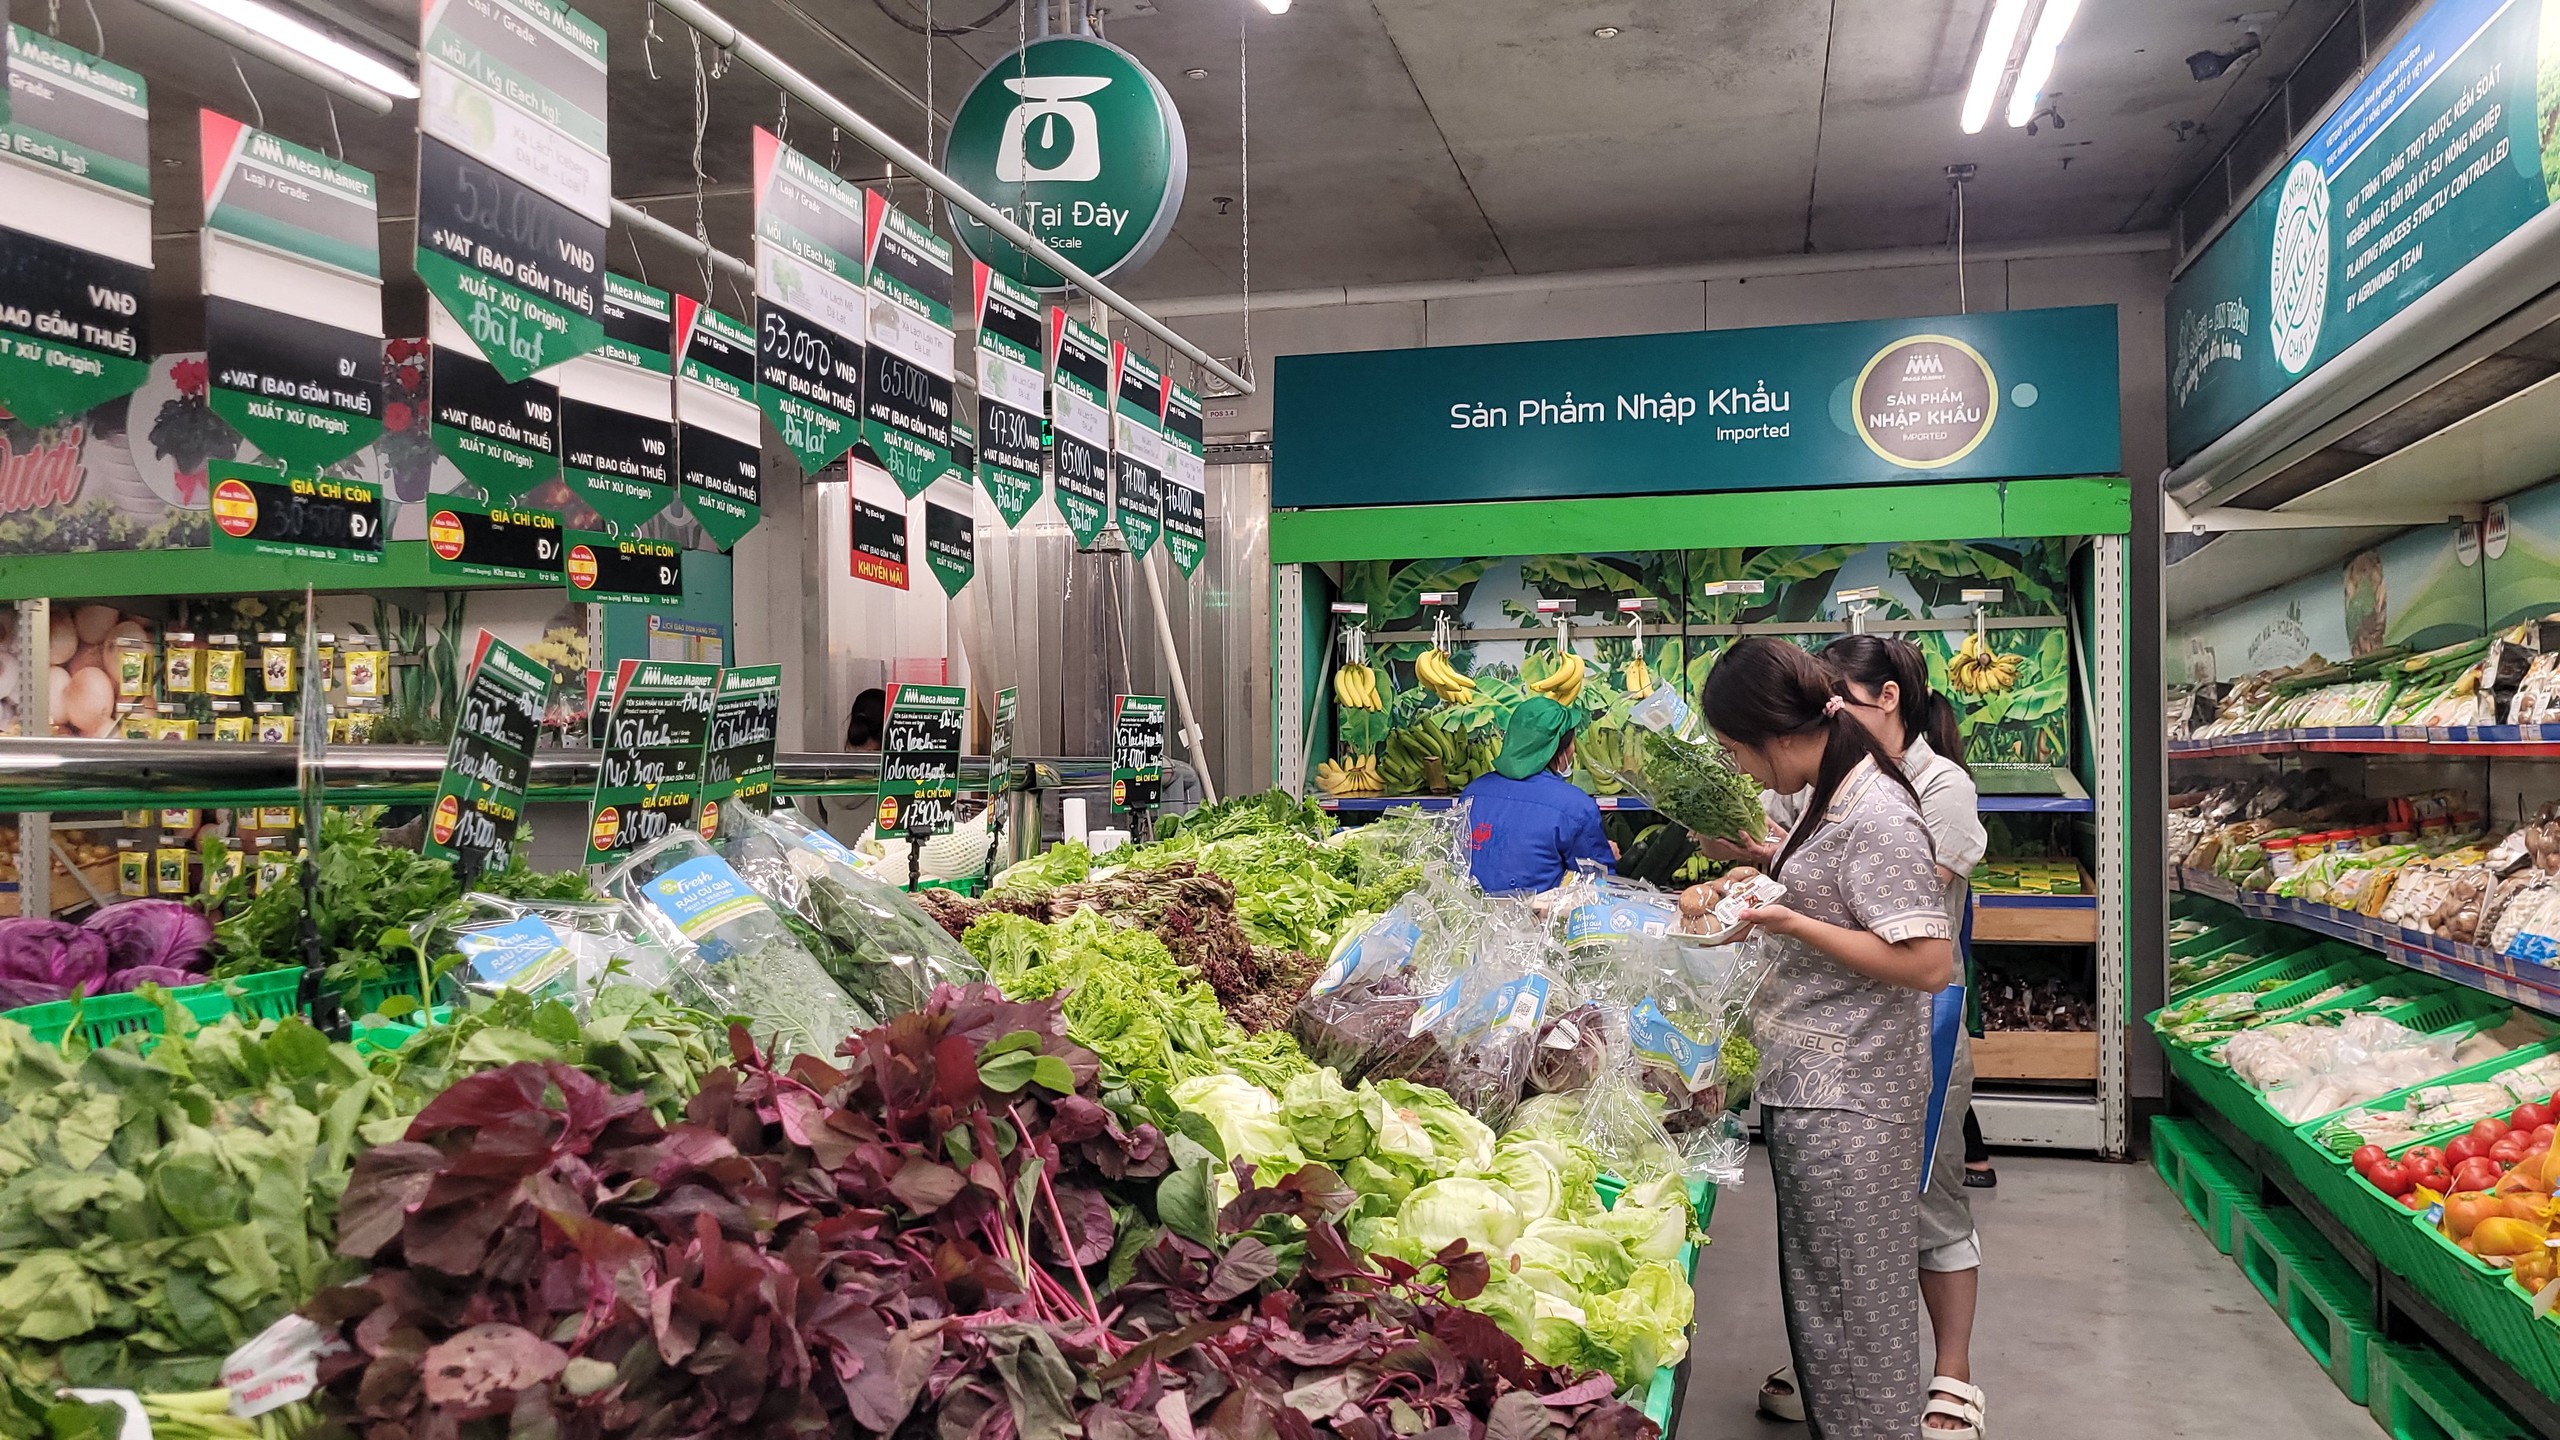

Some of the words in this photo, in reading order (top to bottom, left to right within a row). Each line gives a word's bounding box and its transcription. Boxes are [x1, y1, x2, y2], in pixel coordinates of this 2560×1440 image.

[2345, 188, 2360, 219] QUY
[2360, 178, 2380, 204] TRÌNH
[2380, 151, 2405, 186] TRỒNG
[2405, 131, 2426, 164] TRỌT
[2427, 107, 2453, 145] ĐƯỢC
[2453, 85, 2475, 122] KIỂM
[2475, 62, 2502, 100] SOÁT
[2404, 172, 2418, 200] ĐỘI
[2418, 160, 2430, 189] KỸ
[2445, 133, 2468, 167] NÔNG
[2469, 103, 2501, 147] NGHIỆP
[1026, 201, 1062, 231] Tại
[1072, 201, 1129, 236] Đây
[2346, 246, 2379, 282] PLANTING
[2379, 216, 2412, 256] PROCESS
[2412, 184, 2450, 230] STRICTLY
[2450, 136, 2509, 199] CONTROLLED
[558, 238, 595, 273] VNĐ
[792, 237, 802, 256] Kg
[803, 243, 823, 264] (Each
[1050, 237, 1082, 249] Scale
[432, 229, 474, 258] +VAT
[478, 246, 514, 277] (BAO
[517, 261, 550, 293] GỒM
[553, 278, 594, 315] THUẾ)
[2346, 293, 2359, 313] BY
[2357, 258, 2400, 306] AGRONOMIST
[2400, 241, 2423, 273] TEAM
[88, 285, 137, 315] VNĐ
[458, 274, 498, 302] XUẤT
[606, 344, 627, 360] (Each
[764, 313, 830, 376] 53.000
[835, 360, 856, 384] VNĐ
[881, 356, 929, 408] 65.000
[765, 366, 787, 386] +VAT
[790, 374, 810, 394] (BAO
[812, 380, 830, 404] GỒM
[832, 393, 856, 416] THUẾ)
[1887, 391, 1916, 406] SẢN
[1921, 387, 1963, 404] PHẨM
[526, 401, 552, 422] VNĐ
[929, 396, 948, 418] VNĐ
[1450, 401, 1507, 429] Sản
[1519, 391, 1605, 426] Phẩm
[1617, 391, 1696, 426] Nhập
[1708, 379, 1790, 416] Khẩu
[1870, 408, 1921, 430] NHẬP
[1928, 403, 1980, 425] KHẨU
[441, 408, 468, 426] +VAT
[471, 415, 495, 433] (BAO
[498, 419, 520, 441] GỒM
[523, 430, 552, 452] THUẾ)
[870, 403, 890, 421] +VAT
[892, 410, 909, 429] (BAO
[911, 415, 926, 436] GỒM
[928, 426, 948, 446] THUẾ)
[989, 405, 1027, 450] 47.300
[1716, 421, 1790, 444] Imported
[1903, 431, 1947, 441] IMPORTED
[459, 437, 485, 454] XUẤT
[503, 451, 534, 469] (Origin):
[642, 438, 665, 456] VNĐ
[1027, 434, 1039, 450] VNĐ
[570, 452, 594, 466] +VAT
[596, 456, 618, 471] (BAO
[620, 457, 639, 475] GỒM
[641, 464, 666, 482] THUẾ)
[739, 461, 756, 478] VNĐ
[1061, 439, 1091, 481] 65.000
[291, 478, 315, 496] GIÁ
[319, 483, 341, 499] CHỈ
[345, 486, 372, 503] CÒN
[588, 475, 610, 490] XUẤT
[626, 484, 652, 500] (Origin):
[686, 471, 704, 485] +VAT
[706, 475, 722, 490] (BAO
[723, 478, 737, 495] GỒM
[739, 485, 756, 503] THUẾ)
[491, 508, 510, 523] GIÁ
[513, 512, 530, 526] CHỈ
[533, 514, 555, 529] CÒN
[537, 538, 559, 559] Đ/
[620, 541, 635, 554] GIÁ
[638, 543, 653, 555] CHỈ
[656, 545, 674, 558] CÒN
[659, 566, 678, 586] Đ/
[858, 560, 888, 584] KHUYẾN
[889, 567, 903, 585] MÃI
[642, 794, 656, 809] GIÁ
[658, 792, 673, 807] CHỈ
[673, 793, 689, 806] CÒN
[755, 783, 768, 794] CÒN
[915, 789, 925, 799] GIÁ
[938, 788, 951, 798] CÒN
[677, 871, 713, 894] Fresh
[675, 893, 698, 910] RAU
[490, 951, 515, 969] RAU
